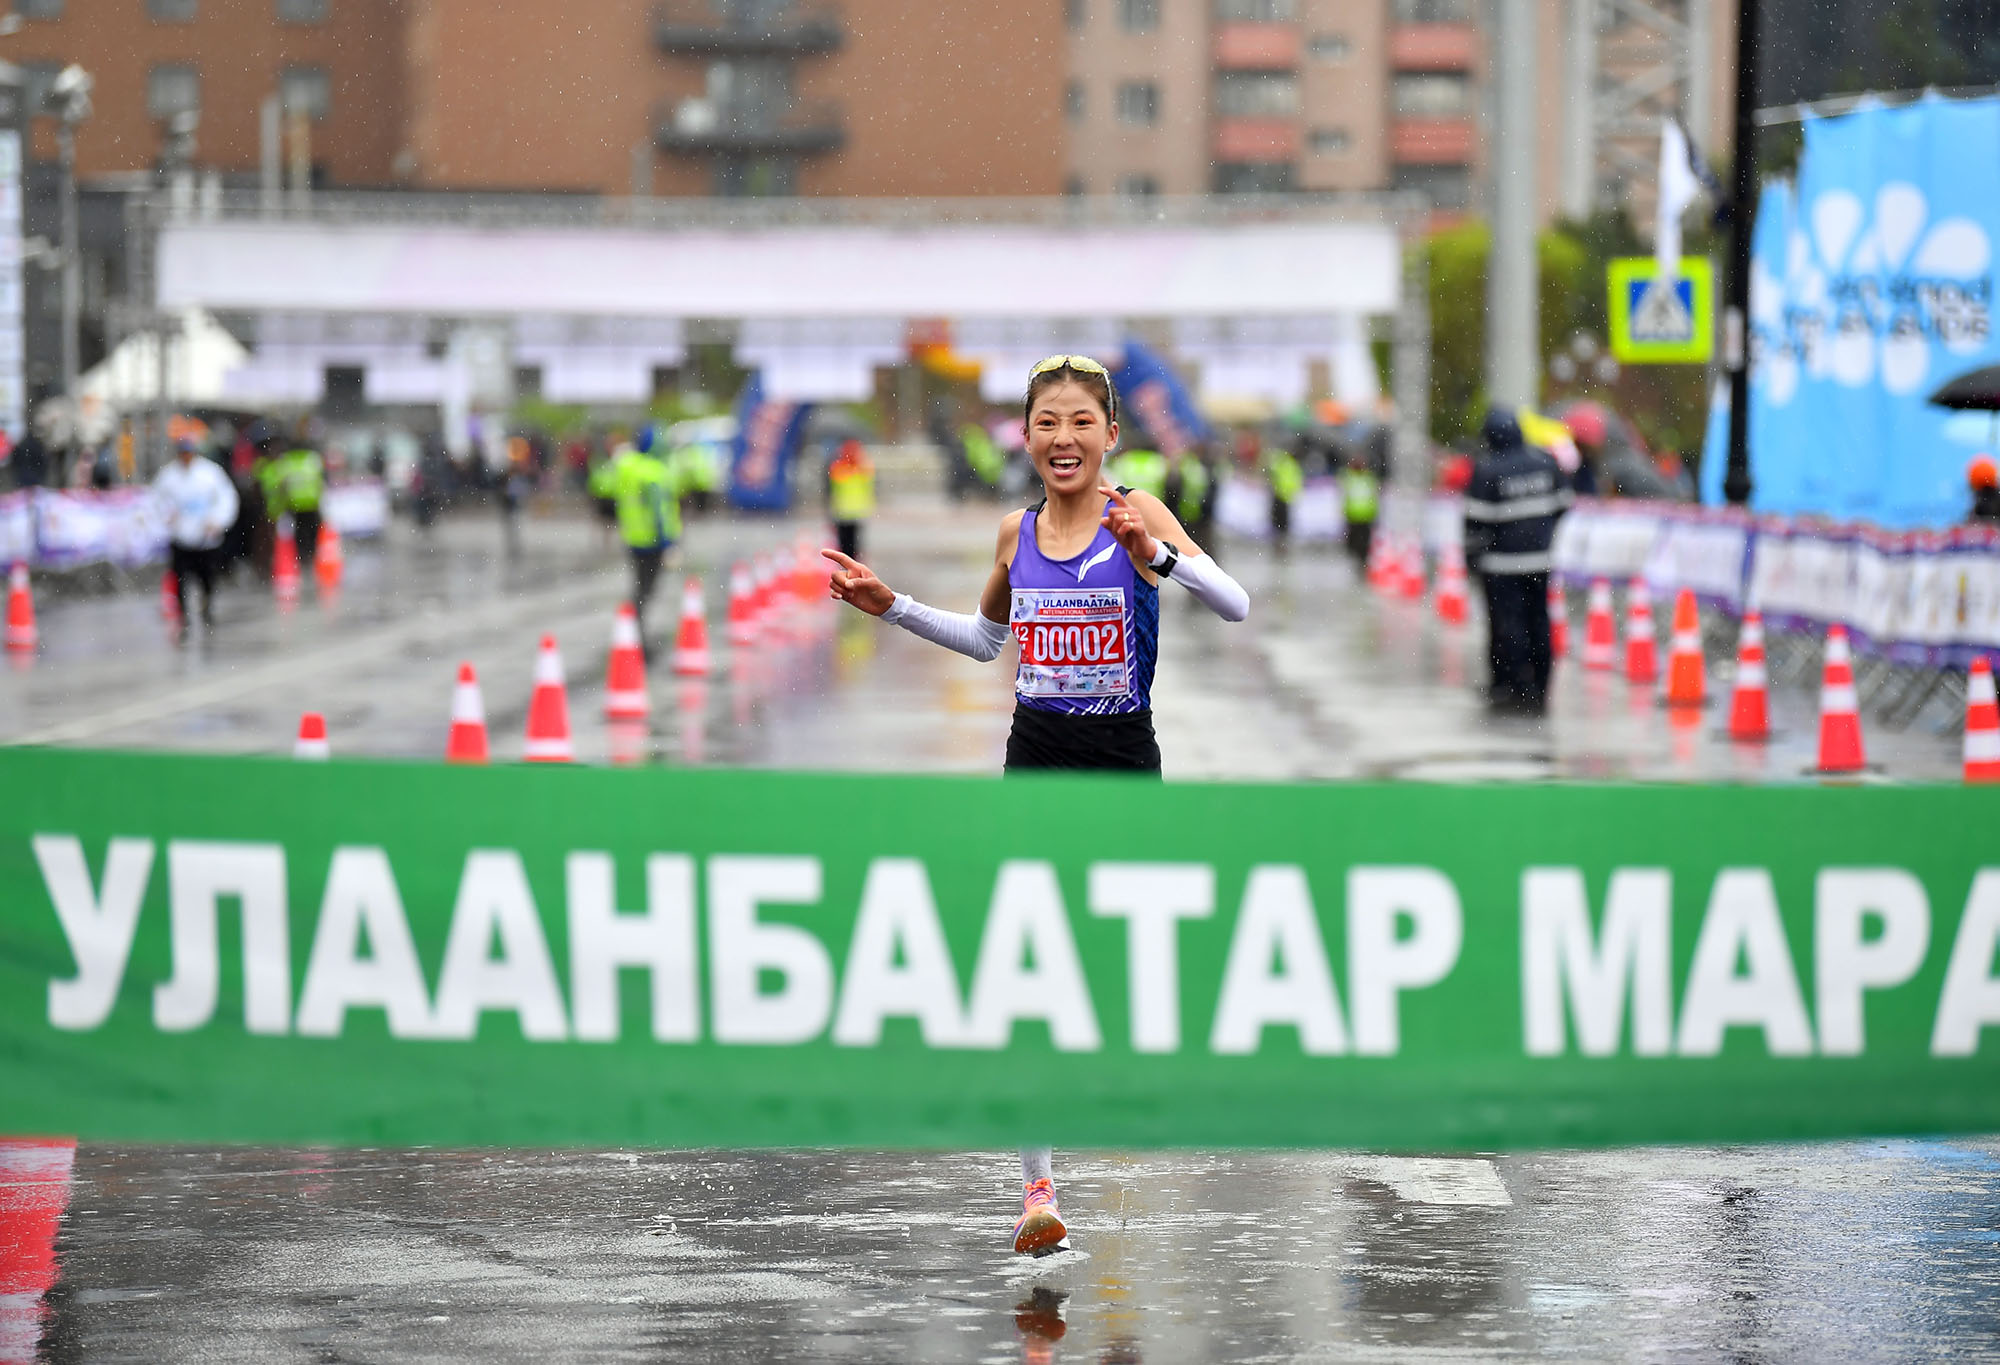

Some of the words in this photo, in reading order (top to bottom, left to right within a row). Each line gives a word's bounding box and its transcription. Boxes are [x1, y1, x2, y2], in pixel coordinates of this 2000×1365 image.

[1042, 598, 1119, 608] ULAANBAATAR
[1014, 626, 1029, 641] 42
[1033, 624, 1120, 662] 00002
[33, 834, 1462, 1056] УЛААНБААТАР
